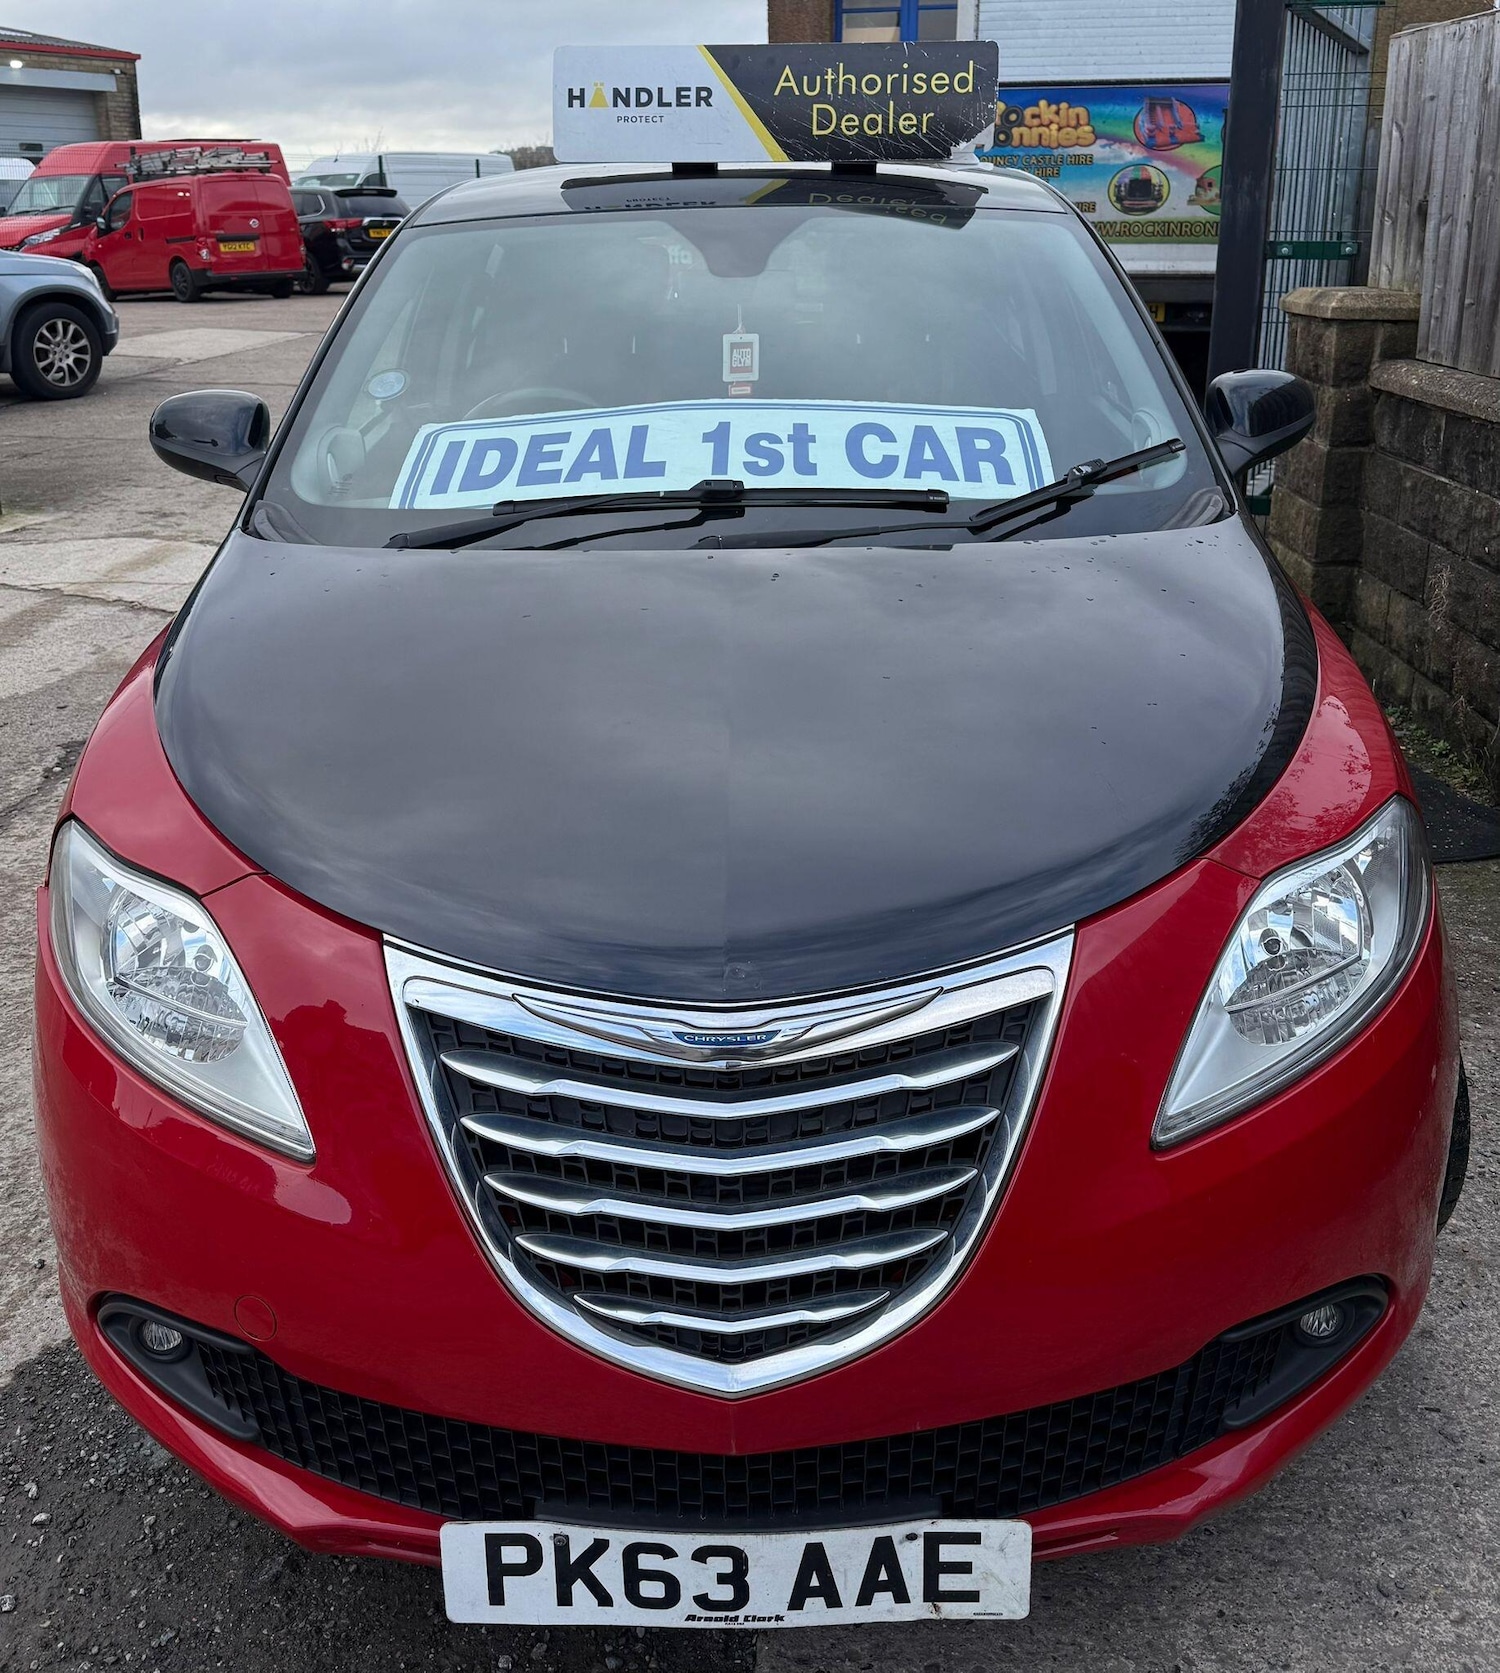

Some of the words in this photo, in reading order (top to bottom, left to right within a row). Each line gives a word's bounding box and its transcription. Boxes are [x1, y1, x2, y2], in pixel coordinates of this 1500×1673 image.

[774, 60, 974, 97] Authorised
[616, 115, 664, 123] PROTECT
[811, 102, 934, 137] Dealer
[1022, 154, 1064, 166] CASTLE
[1066, 154, 1093, 165] HIRE
[1034, 167, 1060, 177] HIRE
[733, 348, 752, 358] AUTO
[430, 424, 667, 495] IDEAL
[701, 422, 817, 478] 1st
[845, 422, 1015, 486] CAR
[684, 1034, 767, 1042] CHRYSLER
[484, 1532, 750, 1612] PK63
[786, 1531, 983, 1610] AAE
[684, 1614, 740, 1622] Arnold
[743, 1614, 786, 1623] Clark
